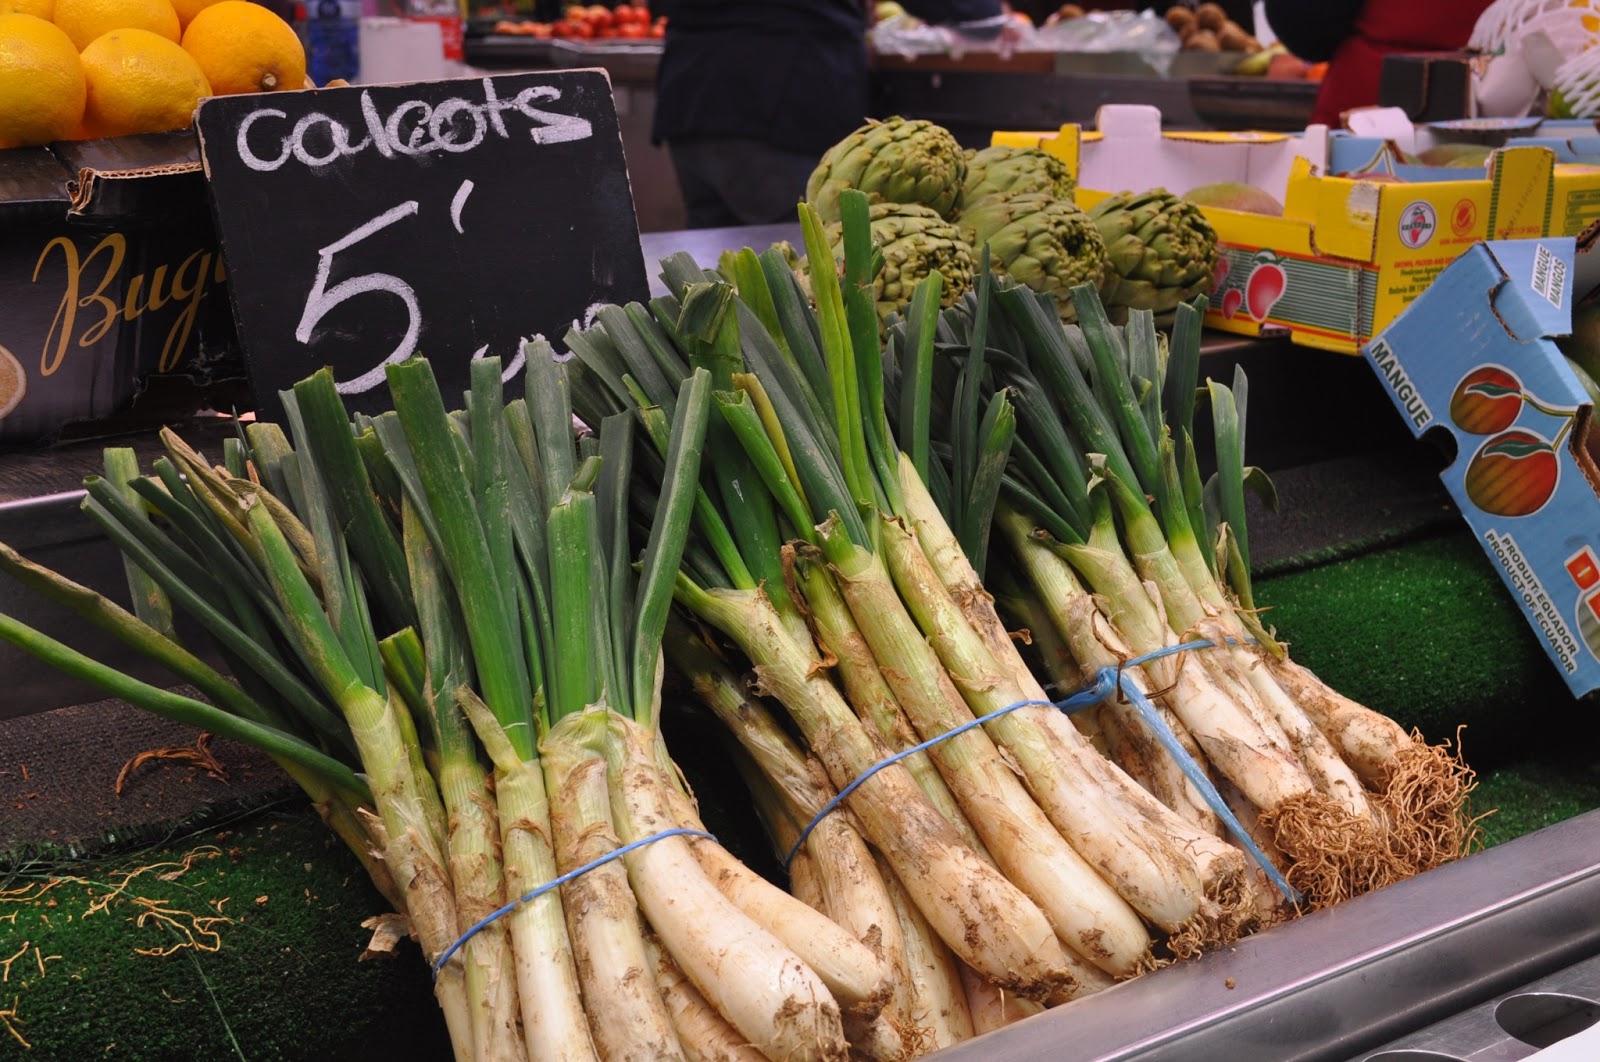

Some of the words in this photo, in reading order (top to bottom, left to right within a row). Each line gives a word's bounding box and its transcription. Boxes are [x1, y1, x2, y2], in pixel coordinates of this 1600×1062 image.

[1534, 246, 1550, 294] MANGUE
[1549, 258, 1565, 306] MANGOS
[1371, 342, 1430, 428] MANGUE
[1486, 533, 1525, 592] PRODUCT
[1523, 594, 1537, 611] OF
[1534, 612, 1575, 673] ECUADOR
[1502, 537, 1540, 592] PRODUIT
[1536, 593, 1577, 655] EQUADOR
